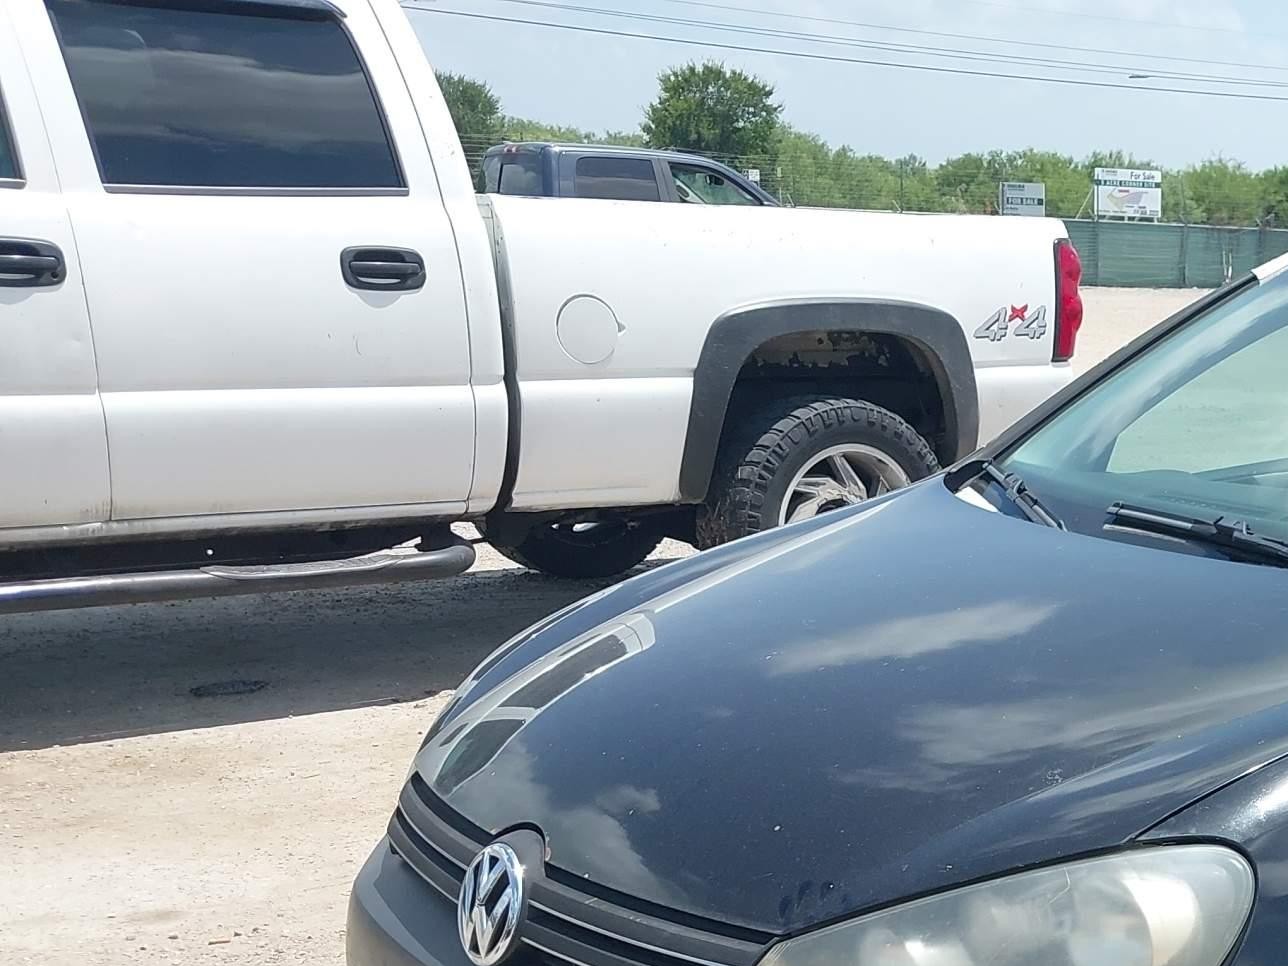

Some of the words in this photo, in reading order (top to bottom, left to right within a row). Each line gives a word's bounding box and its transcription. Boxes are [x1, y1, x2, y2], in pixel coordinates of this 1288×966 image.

[1130, 171, 1141, 181] For
[1008, 197, 1021, 206] FOR
[1022, 197, 1038, 206] SALE
